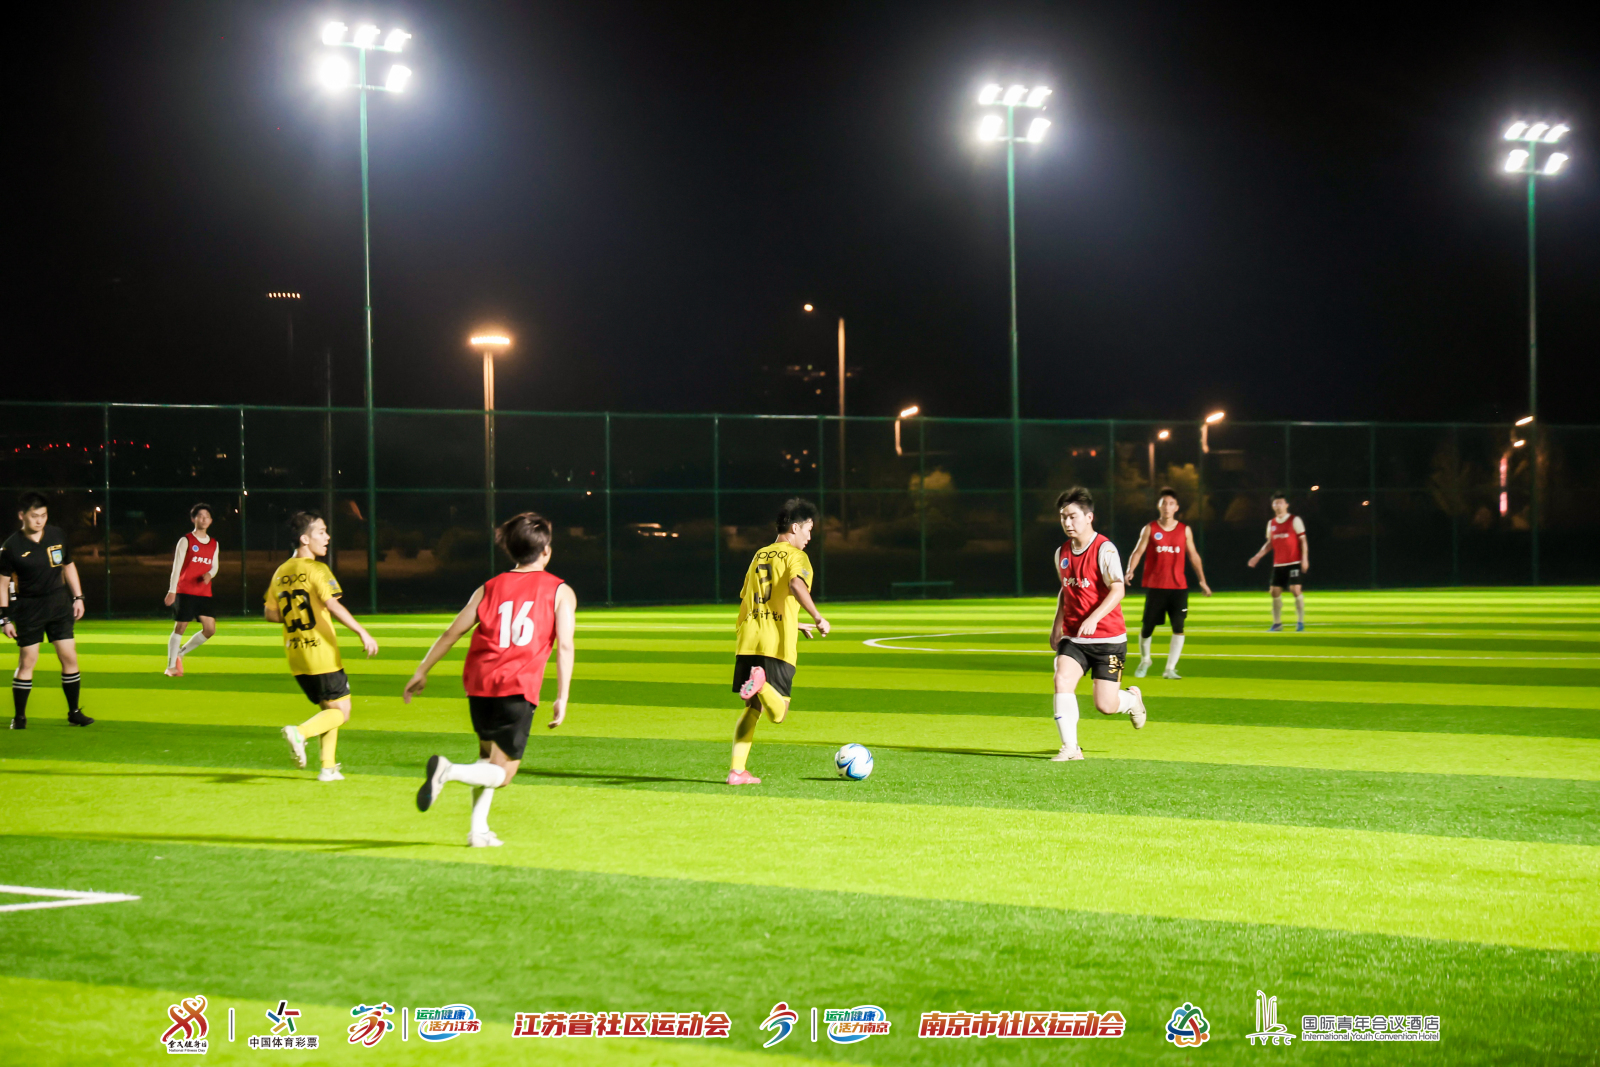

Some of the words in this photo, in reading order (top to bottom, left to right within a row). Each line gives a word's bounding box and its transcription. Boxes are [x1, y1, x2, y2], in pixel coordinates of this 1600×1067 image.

[754, 563, 772, 604] 3
[279, 588, 316, 633] 23
[498, 600, 535, 649] 16
